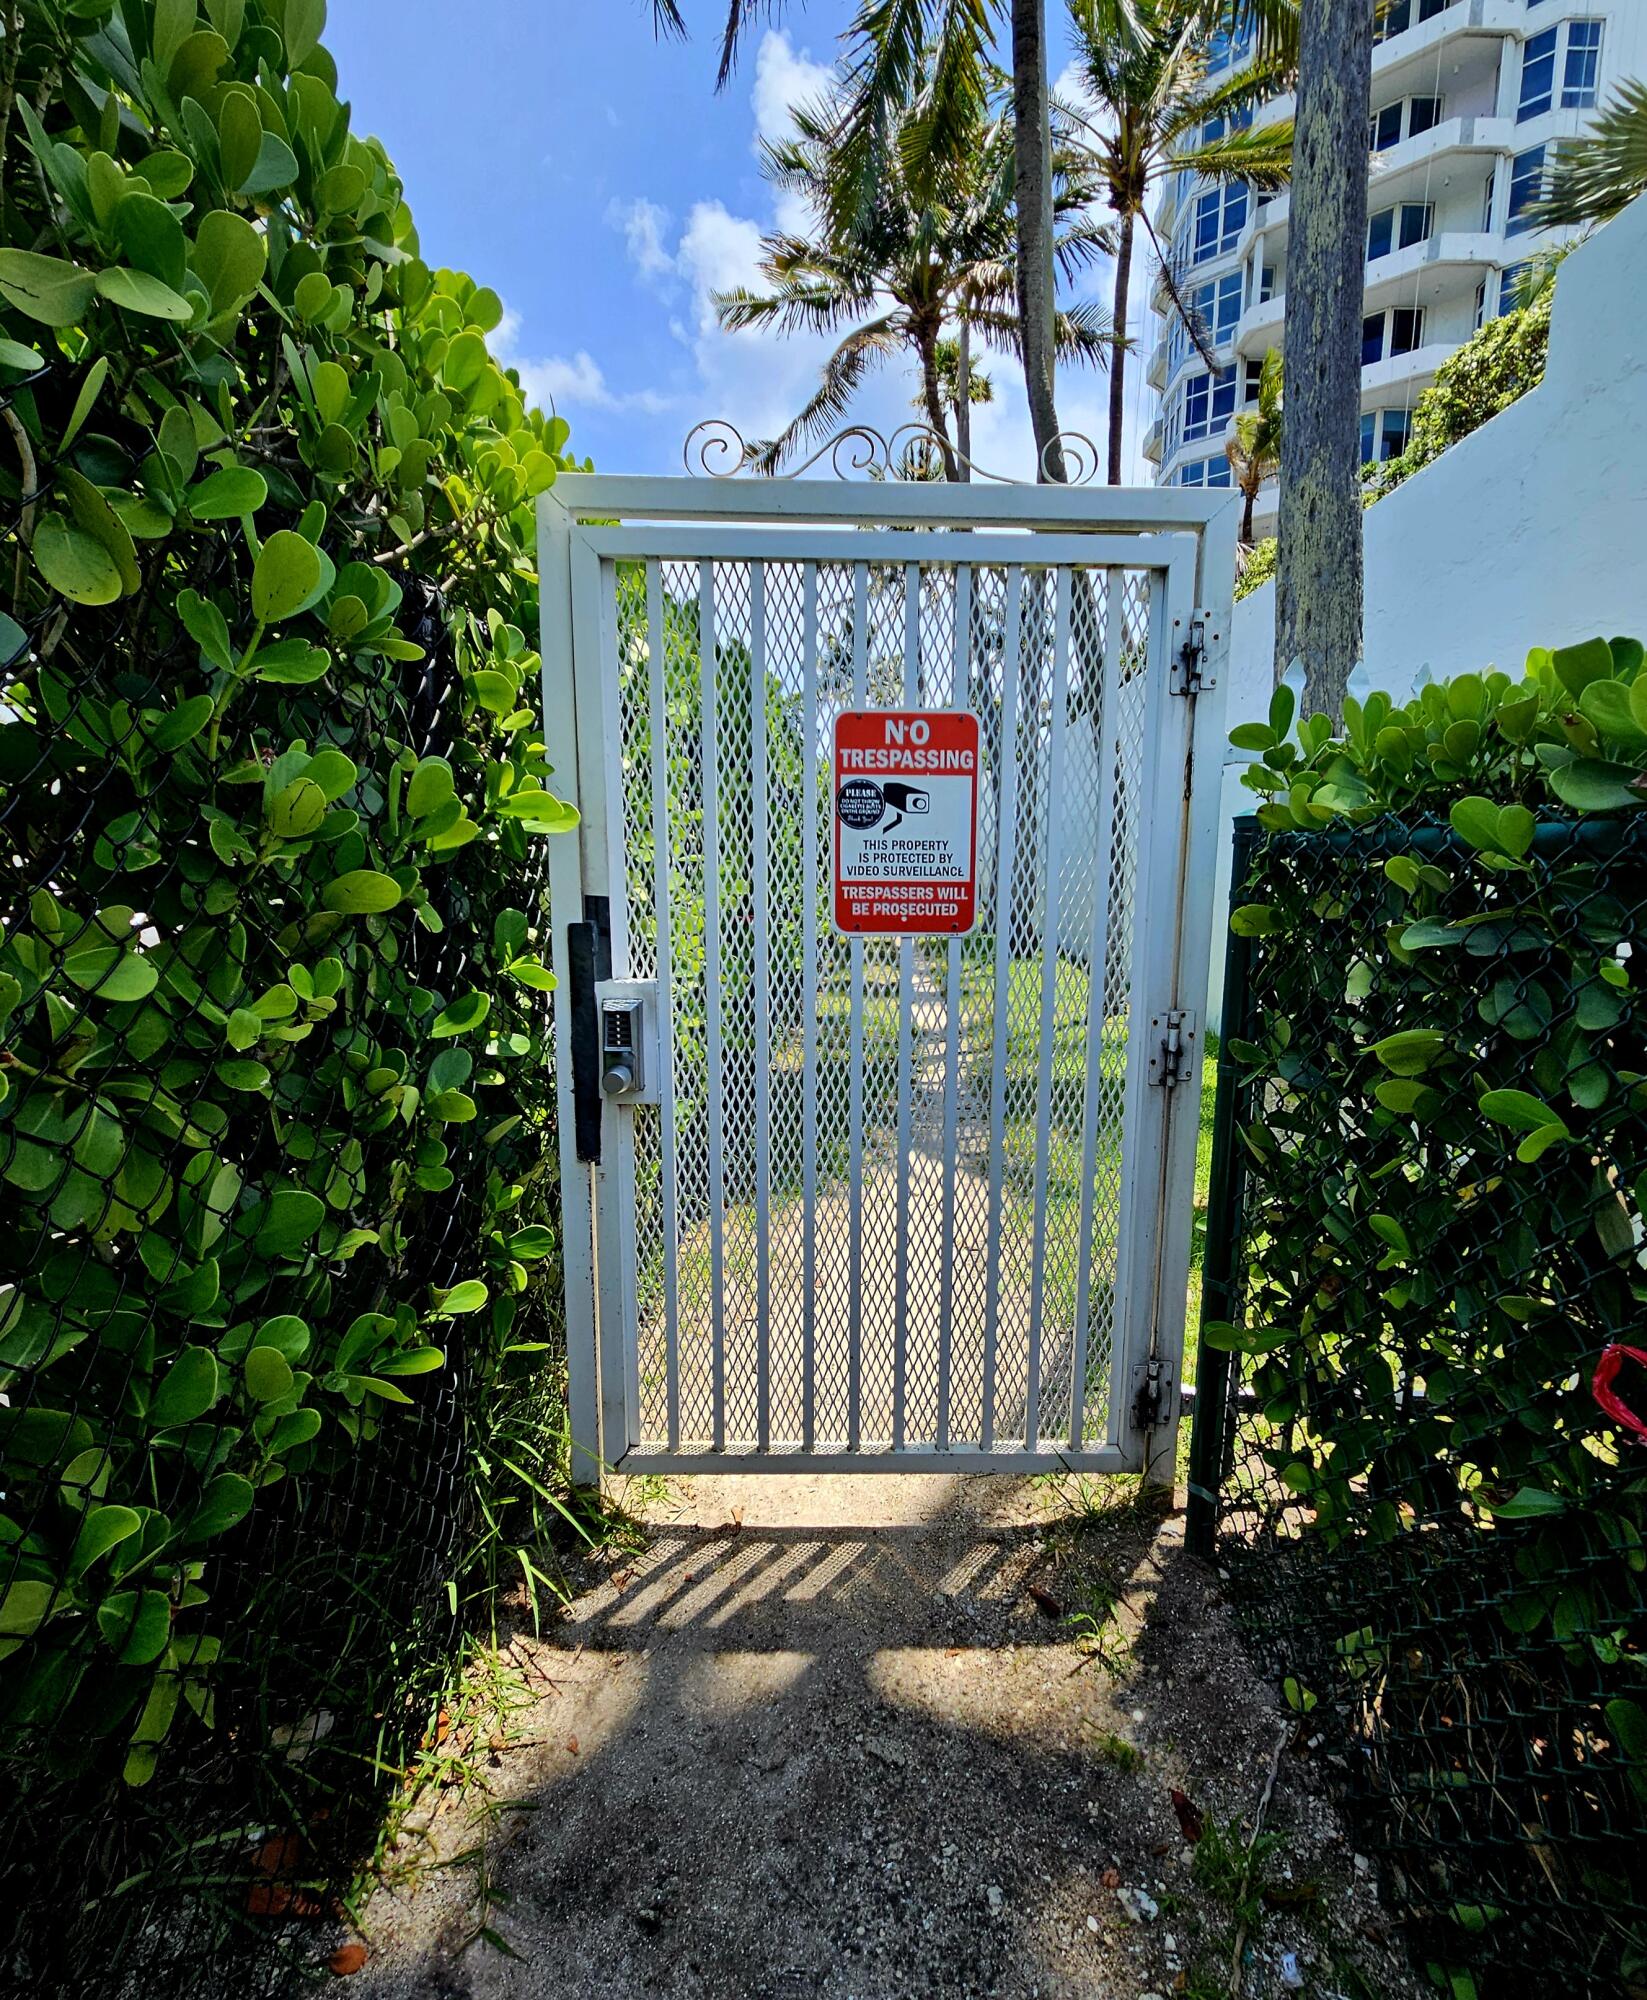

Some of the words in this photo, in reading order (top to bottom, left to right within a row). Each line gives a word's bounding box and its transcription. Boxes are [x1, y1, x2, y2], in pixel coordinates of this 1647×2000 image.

[885, 719, 930, 745] NO
[840, 749, 974, 769] TRESPASSING
[845, 788, 877, 798] PLEASE
[863, 839, 888, 851] THIS
[891, 839, 949, 851] PROPERTY
[858, 852, 870, 863] IS
[873, 852, 935, 864] PROTECTED
[939, 853, 954, 864] BY
[846, 865, 880, 877] VIDEO
[883, 866, 964, 877] SURVEILLANCE
[841, 886, 934, 900] TRESPASSERS
[937, 886, 968, 900] WILL
[851, 902, 869, 916] BE
[872, 902, 959, 916] PROSECUTED
